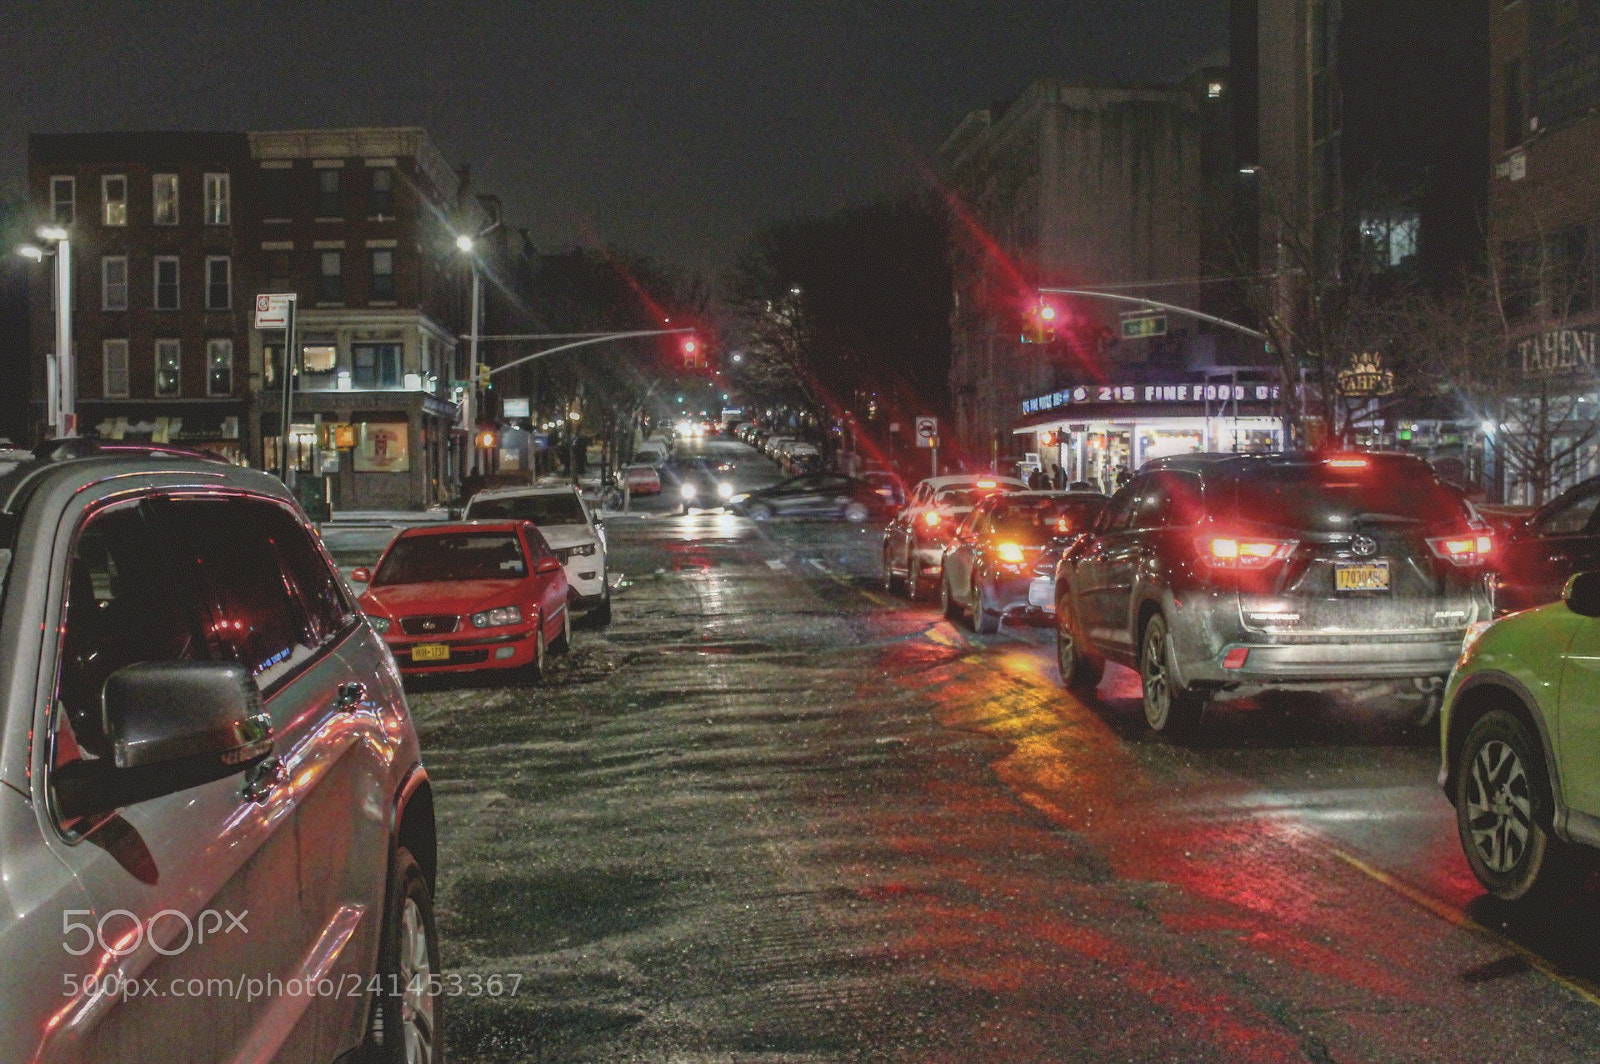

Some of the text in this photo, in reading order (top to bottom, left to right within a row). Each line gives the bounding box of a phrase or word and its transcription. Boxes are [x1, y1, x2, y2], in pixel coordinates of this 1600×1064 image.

[1518, 330, 1596, 373] TAHENI
[1098, 386, 1135, 400] 215
[1144, 386, 1187, 400] FINE
[1193, 385, 1245, 400] FOOD
